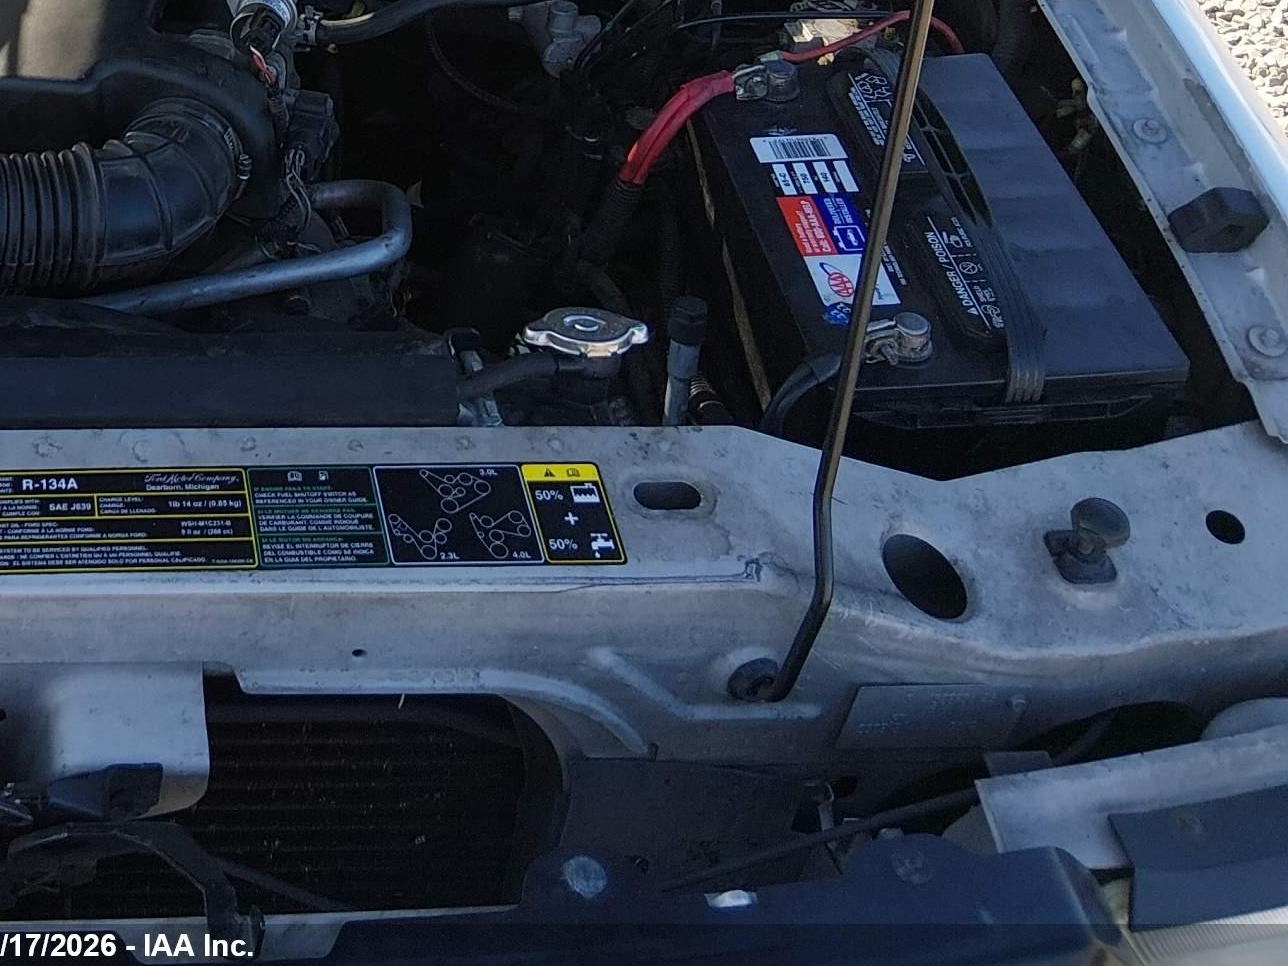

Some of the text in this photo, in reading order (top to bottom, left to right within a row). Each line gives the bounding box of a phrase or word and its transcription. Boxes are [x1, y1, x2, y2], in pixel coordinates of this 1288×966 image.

[799, 172, 811, 184] 750
[923, 231, 950, 264] POISON
[829, 273, 854, 296] AAA
[946, 270, 975, 307] DANGER
[144, 473, 167, 483] Ford
[479, 468, 499, 476] 3.0L
[21, 477, 79, 491] R-134A
[535, 489, 564, 501] 50%
[548, 538, 578, 550] 50%
[440, 551, 460, 560] 2.3L
[511, 551, 532, 559] 4.0L
